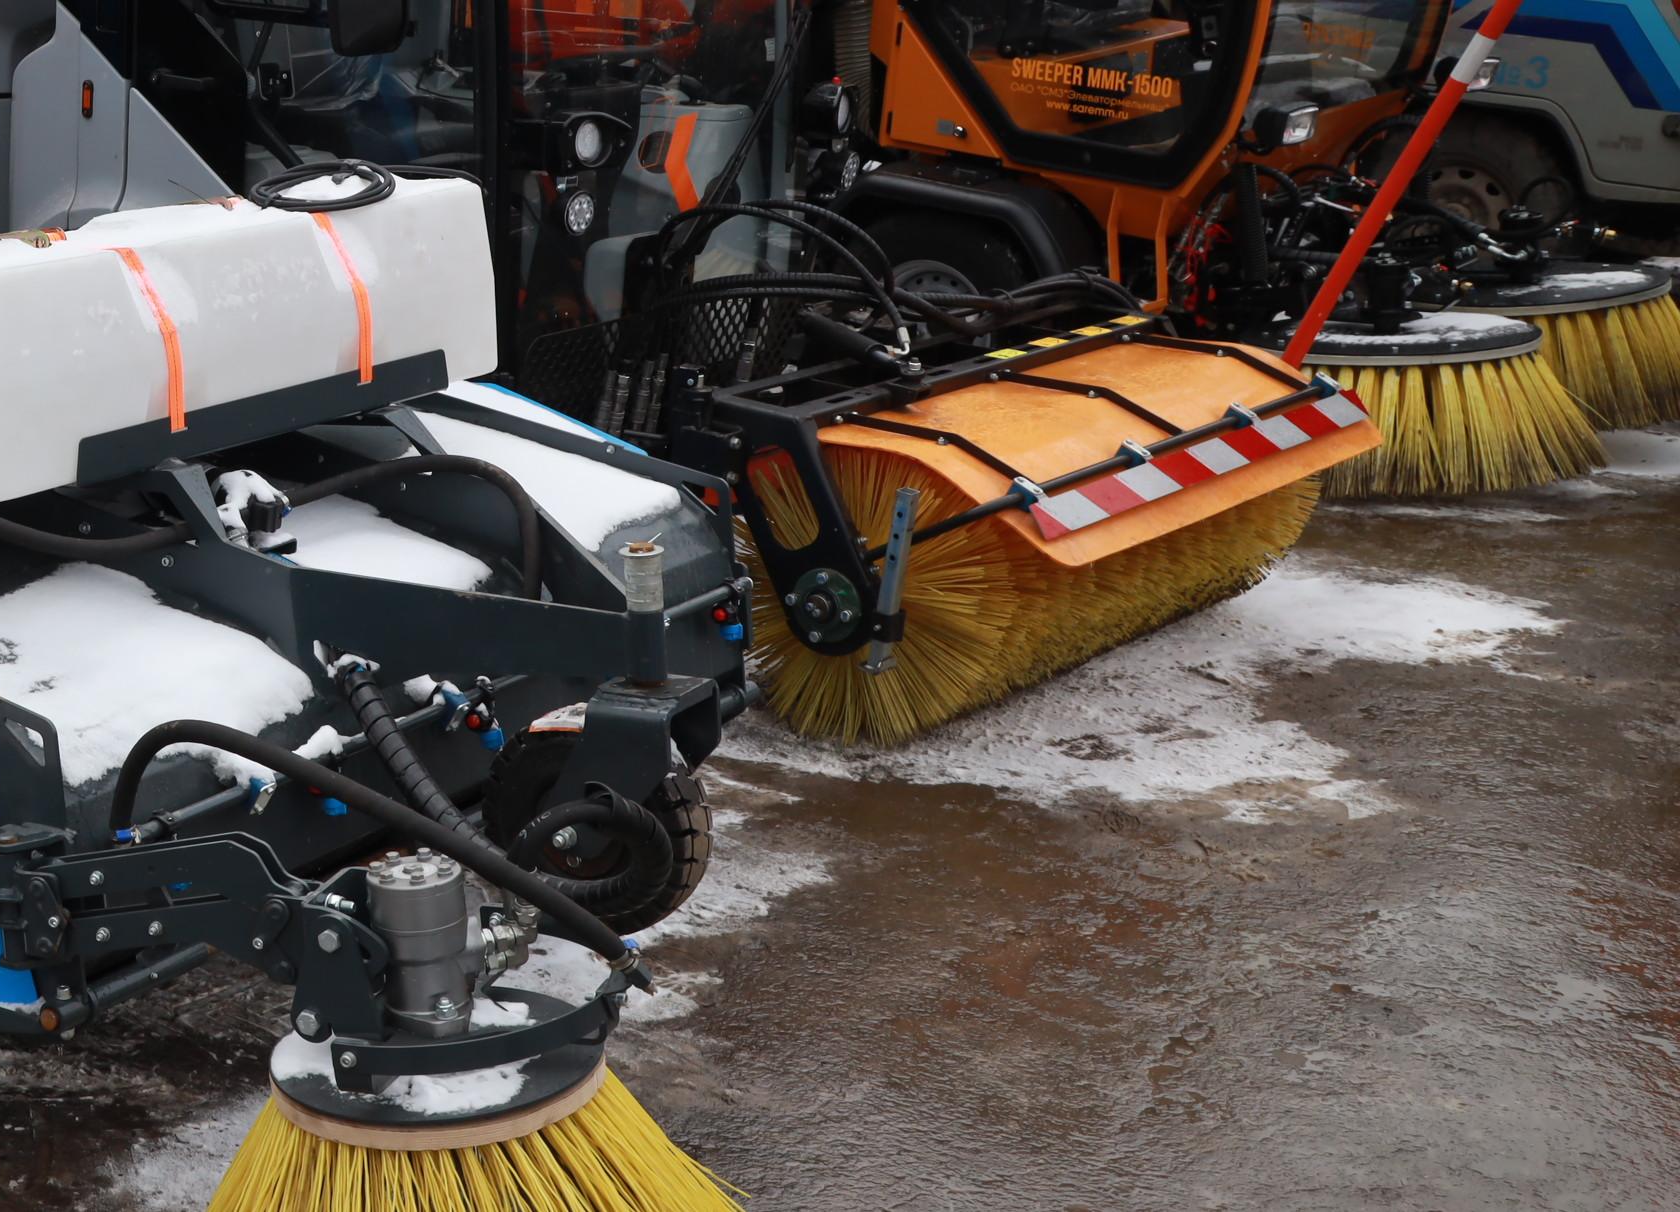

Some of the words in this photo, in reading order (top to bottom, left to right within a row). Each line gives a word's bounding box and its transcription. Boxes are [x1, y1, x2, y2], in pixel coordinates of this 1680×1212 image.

[1011, 57, 1083, 86] SWEEPER
[1010, 82, 1035, 95] ОАО
[1046, 100, 1129, 121] www.saremm.ru
